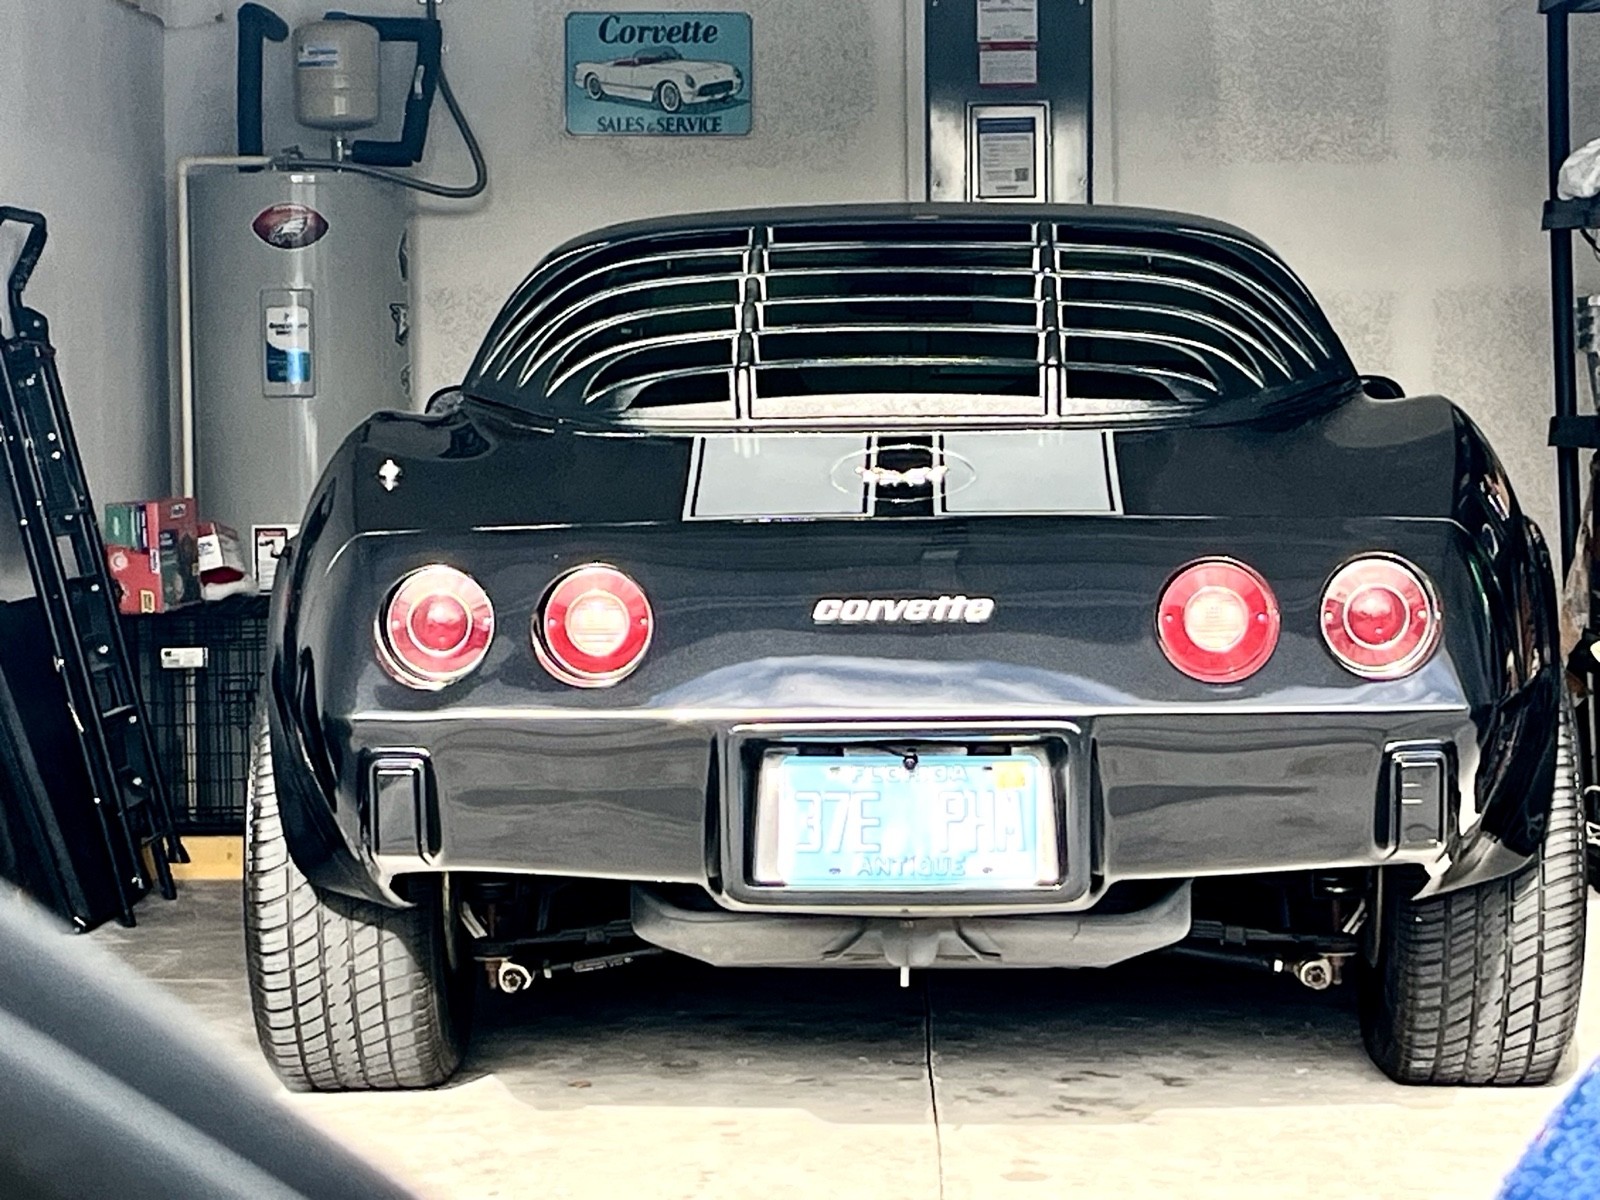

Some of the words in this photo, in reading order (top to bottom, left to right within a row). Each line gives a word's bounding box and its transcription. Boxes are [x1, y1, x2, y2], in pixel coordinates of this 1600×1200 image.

[599, 15, 718, 44] Corvette
[597, 116, 645, 132] SALES
[656, 116, 722, 132] SERVICE
[811, 595, 996, 624] corvette
[794, 790, 882, 854] 37E
[857, 855, 967, 877] ANTIQUE
